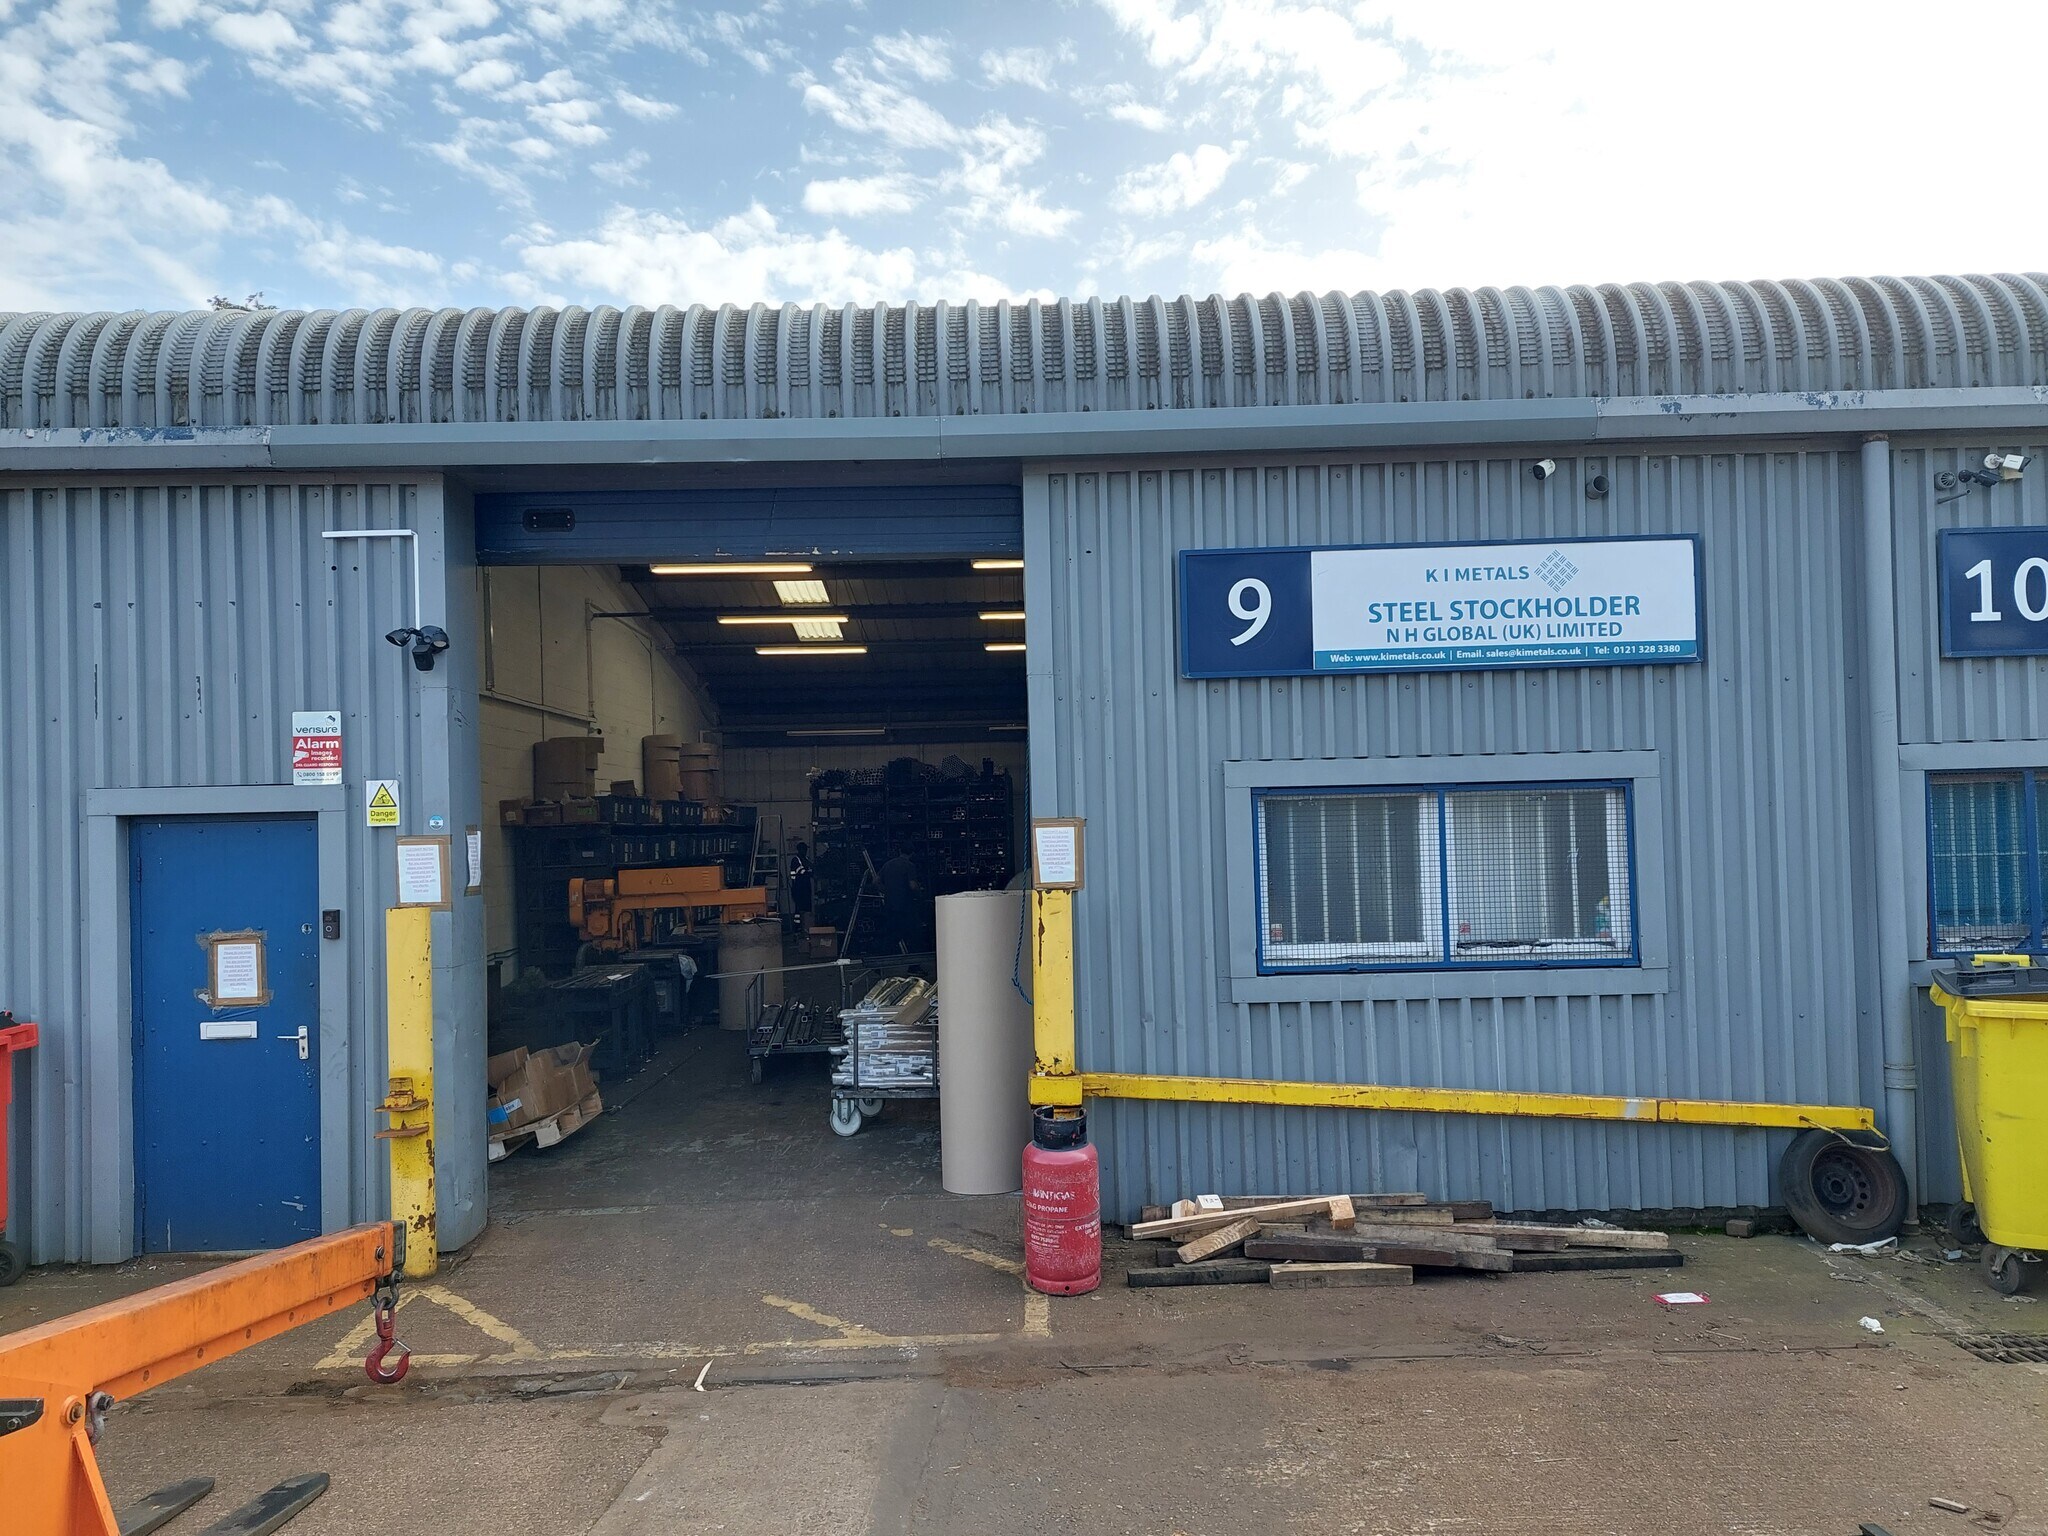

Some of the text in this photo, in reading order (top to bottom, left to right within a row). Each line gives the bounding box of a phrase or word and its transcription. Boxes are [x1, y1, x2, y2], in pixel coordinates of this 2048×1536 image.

[1426, 566, 1530, 582] K I METALS
[1965, 557, 2048, 621] 10
[1228, 578, 1272, 646] 9
[1368, 595, 1641, 623] STEEL STOCKHOLDER
[1387, 621, 1623, 643] N H GLOBAL (UK) LIMITED
[1330, 654, 1353, 663] Web:
[1355, 650, 1446, 662] www.kimetals.co.uk
[1486, 646, 1582, 658] sales@kimetals.co.uk
[1594, 646, 1610, 654] Tel:
[1613, 645, 1638, 654] 0121
[1639, 645, 1656, 653] 328
[1657, 644, 1681, 653] 3380
[295, 726, 338, 734] verisure
[295, 738, 339, 749] Alarm
[370, 810, 396, 818] Danger
[1037, 1205, 1069, 1213] PROPANE
